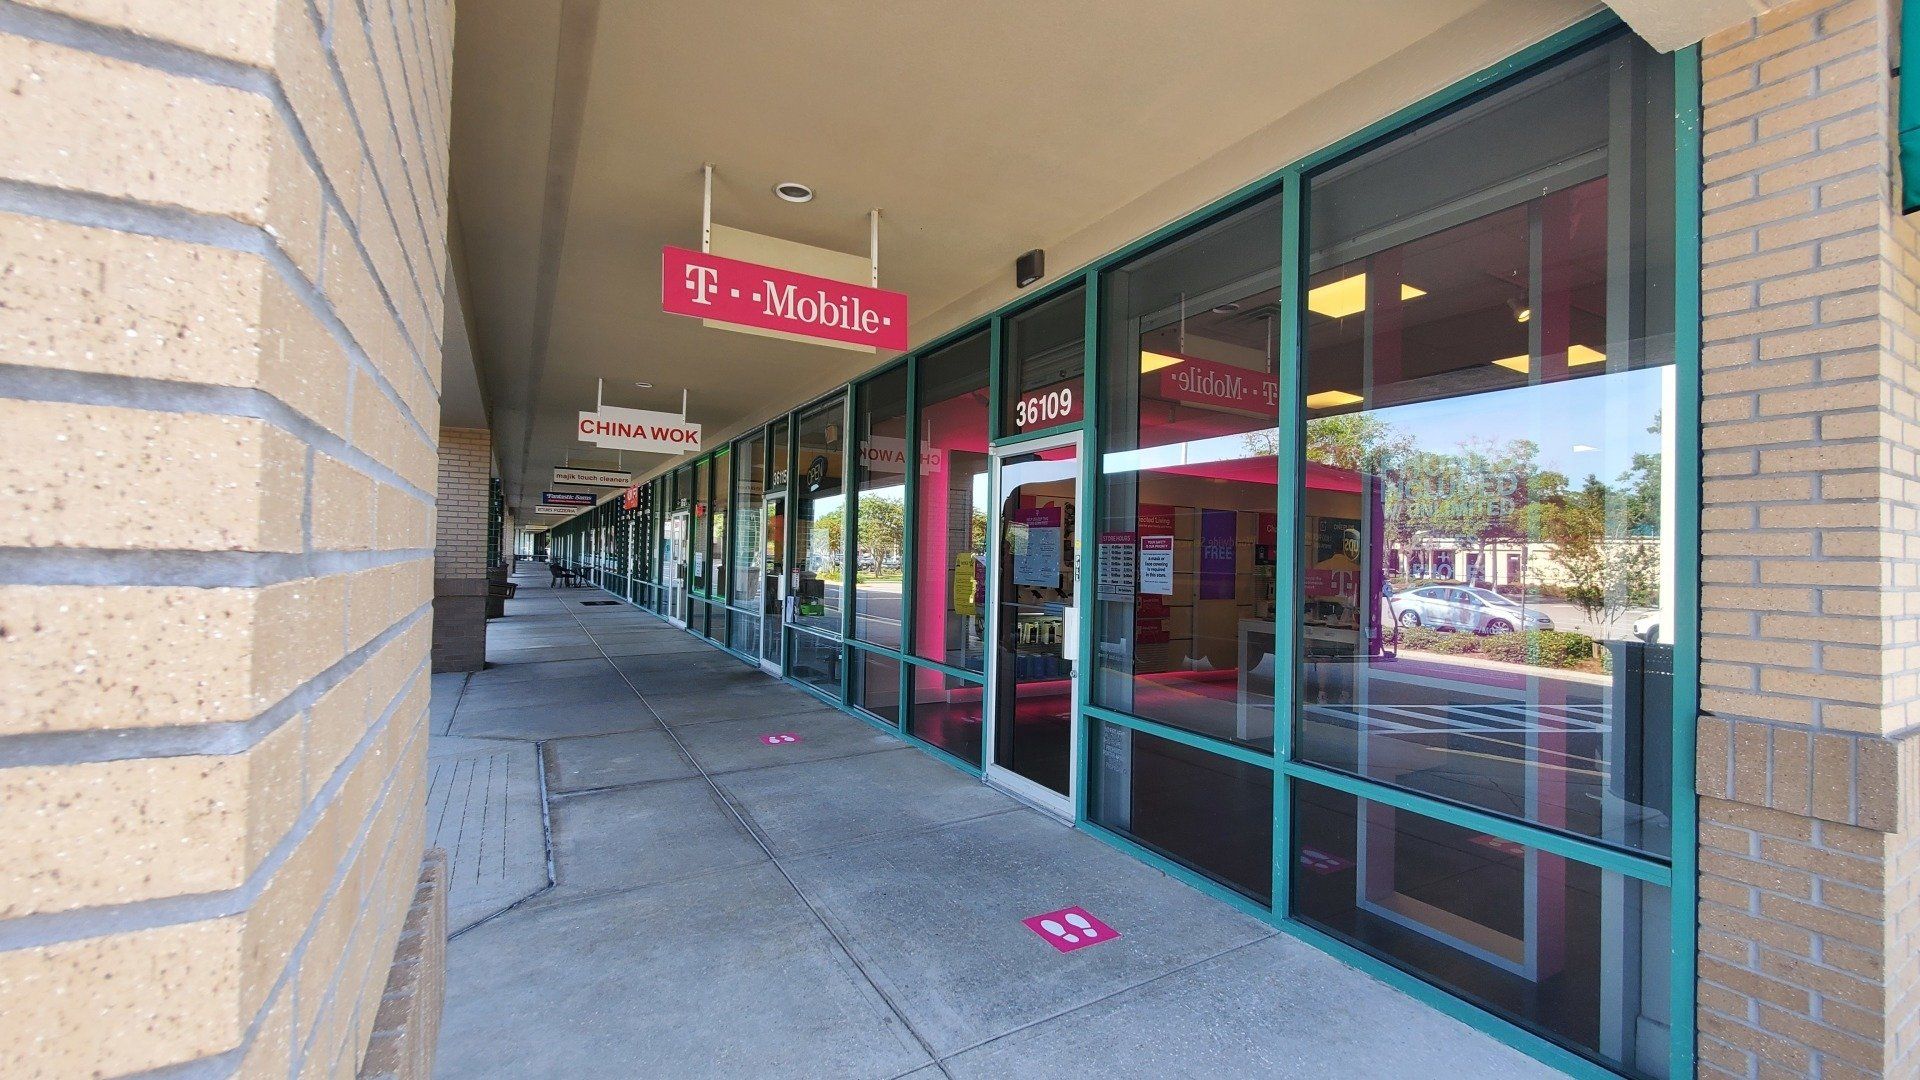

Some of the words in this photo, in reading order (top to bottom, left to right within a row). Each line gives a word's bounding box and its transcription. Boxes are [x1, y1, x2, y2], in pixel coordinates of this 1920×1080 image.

[1016, 388, 1072, 427] 36109
[580, 420, 647, 439] CHINA
[651, 426, 698, 444] WOK
[556, 473, 576, 481] majik
[577, 474, 597, 482] touch
[599, 476, 629, 484] cleaners
[1204, 546, 1232, 560] FREE
